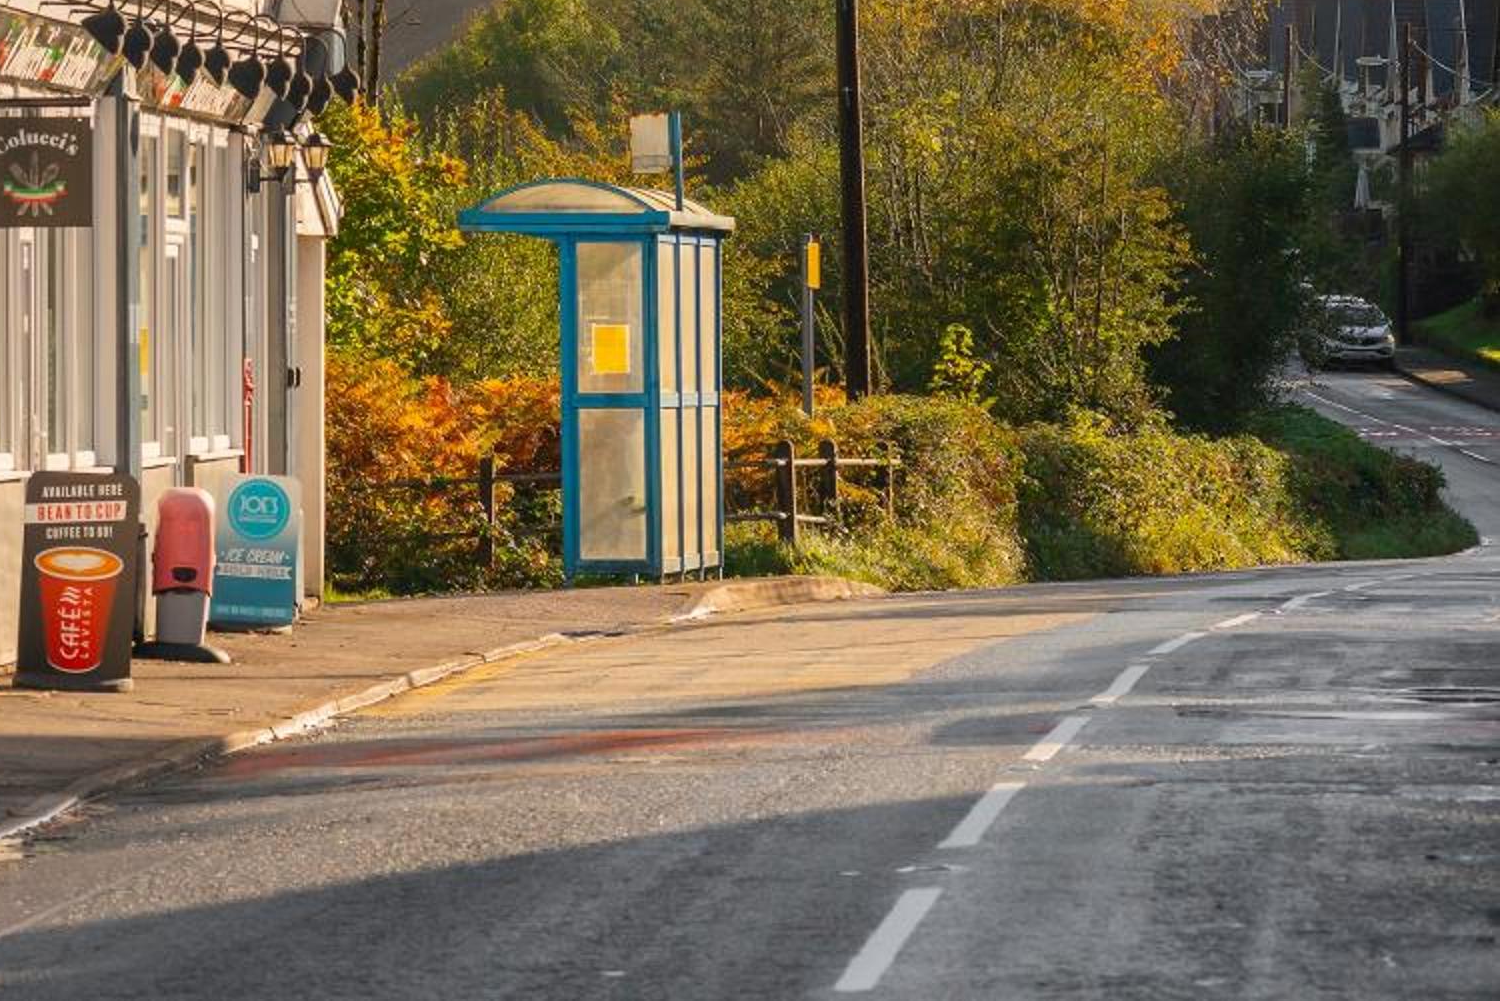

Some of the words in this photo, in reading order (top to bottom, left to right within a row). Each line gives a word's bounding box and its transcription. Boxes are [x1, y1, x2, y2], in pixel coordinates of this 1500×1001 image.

[41, 484, 95, 498] AVAILABLE
[98, 483, 124, 497] HERE
[37, 503, 72, 521] BEAN
[76, 503, 92, 520] TO
[96, 502, 121, 520] CUP
[45, 526, 81, 540] COFFEE
